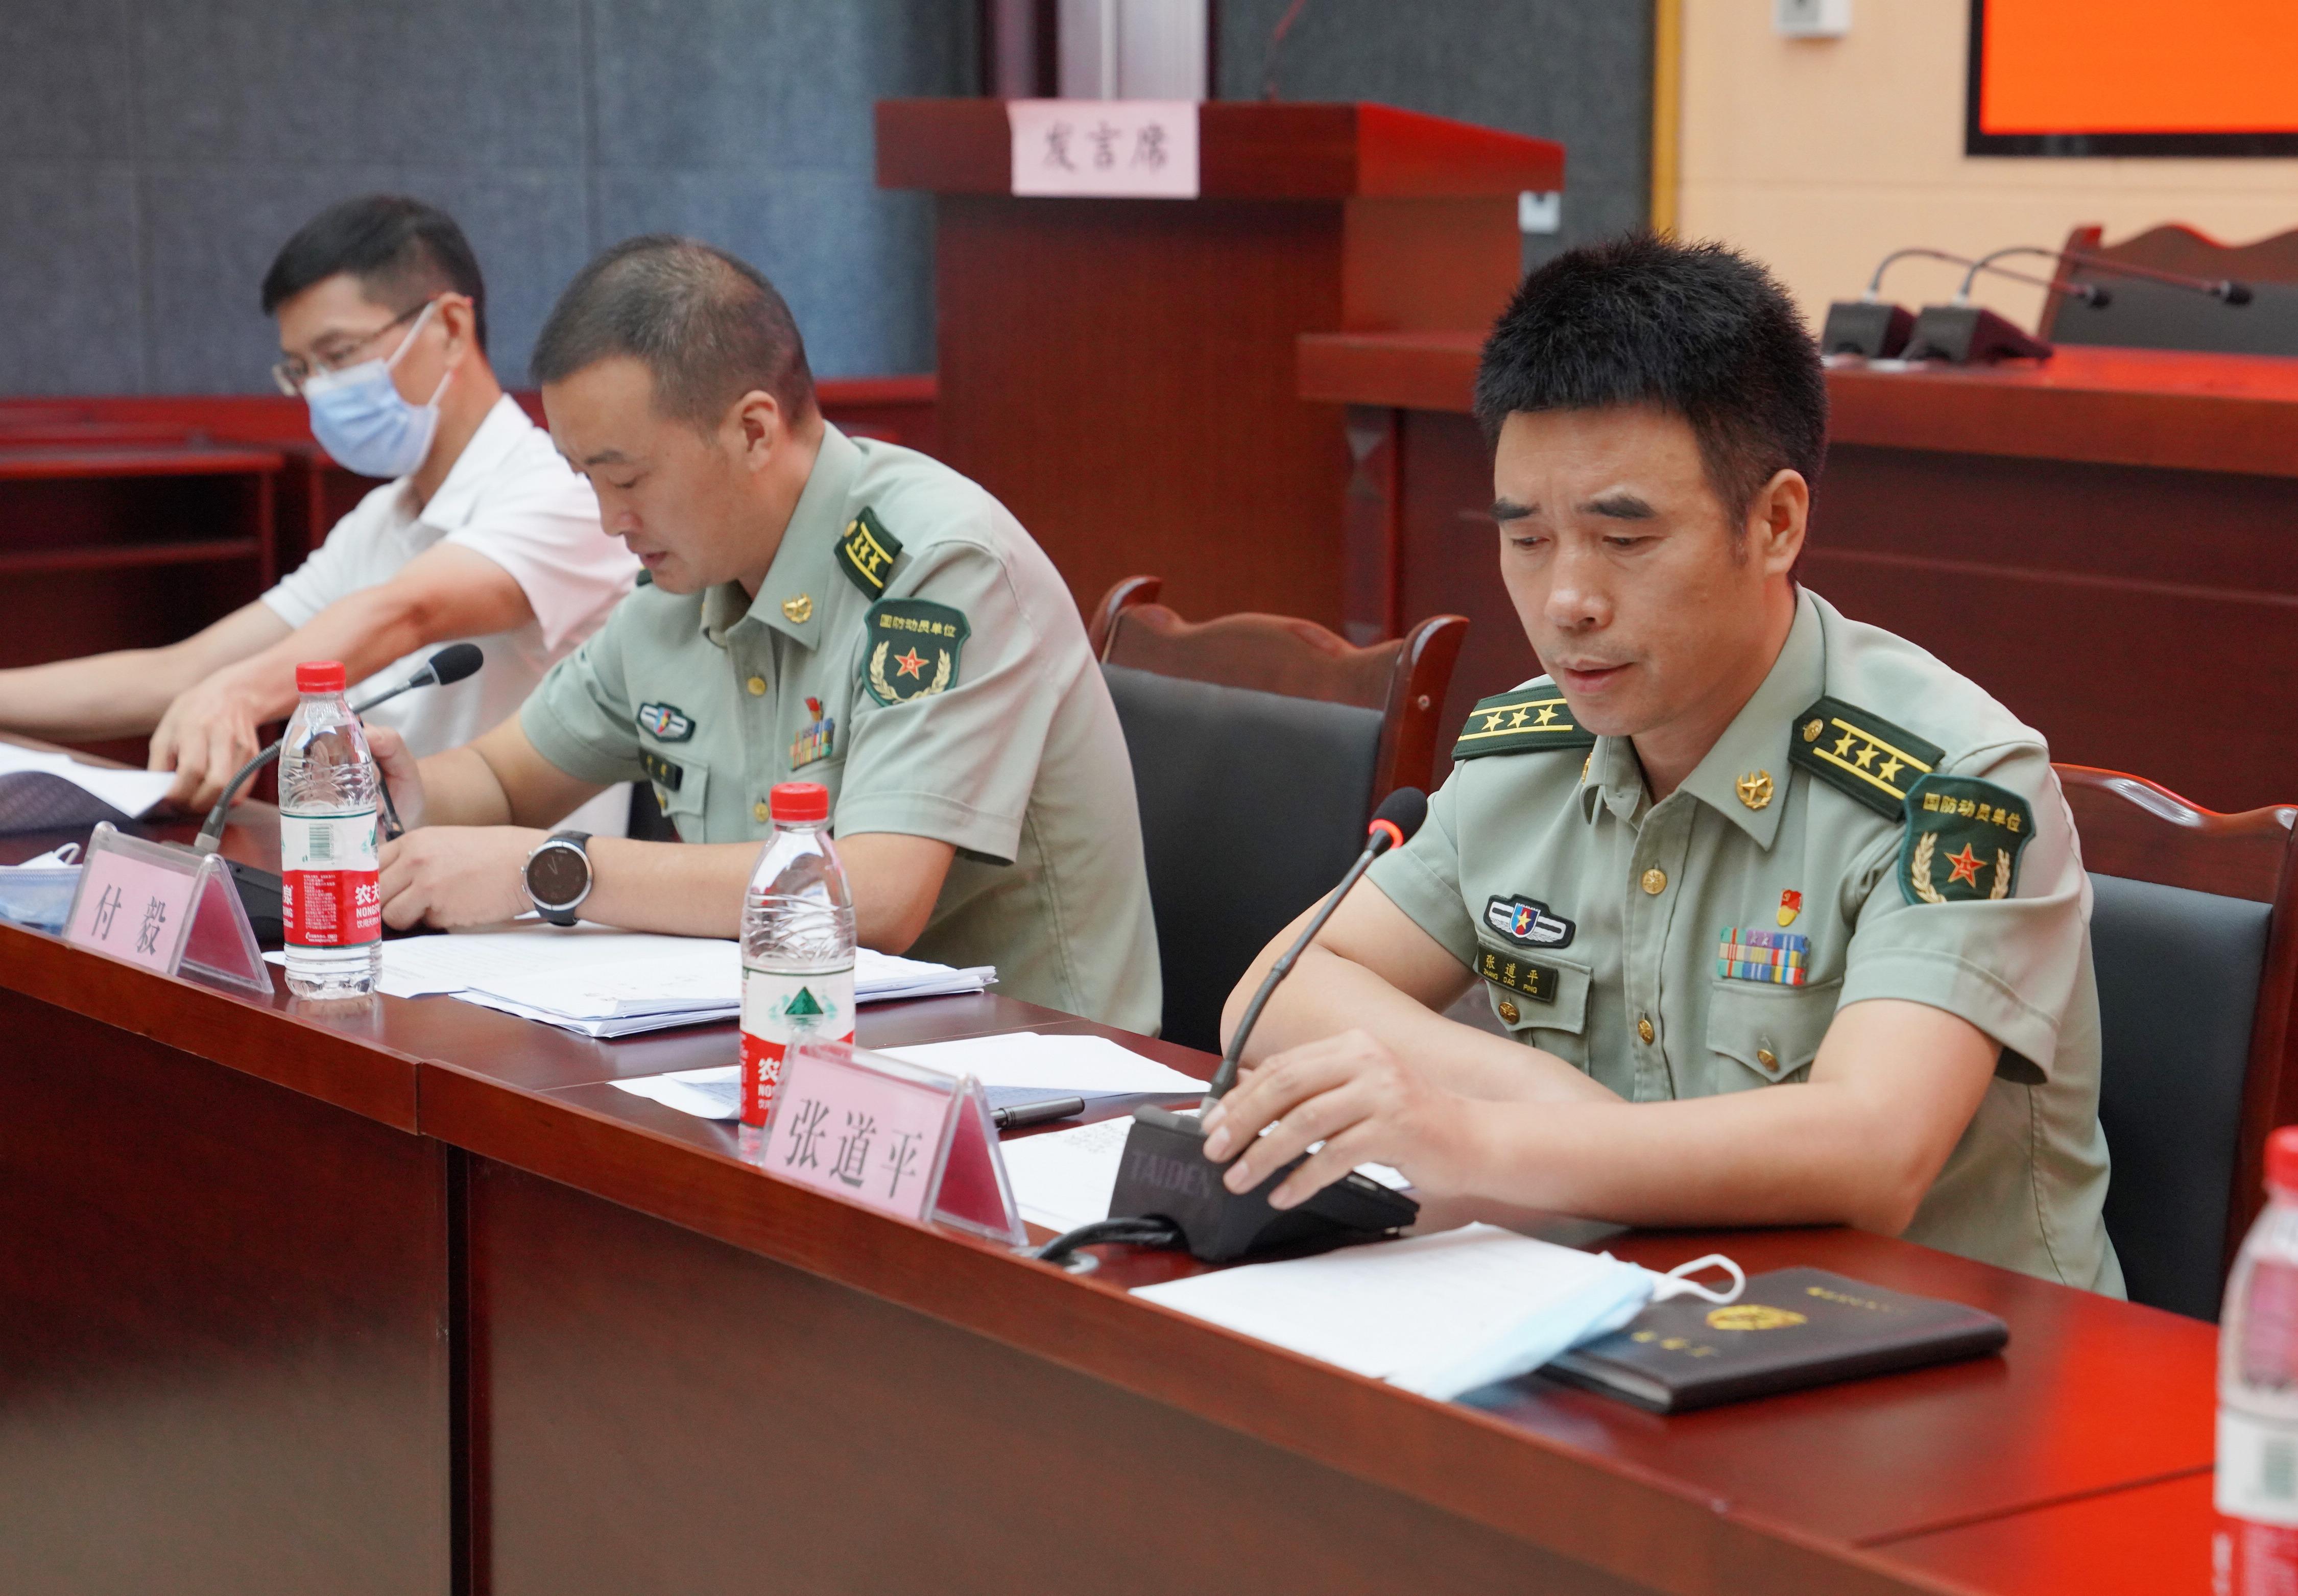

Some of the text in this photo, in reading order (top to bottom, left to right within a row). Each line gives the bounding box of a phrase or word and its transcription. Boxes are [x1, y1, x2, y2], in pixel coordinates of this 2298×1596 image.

[1042, 117, 1170, 175] 发言席
[879, 614, 956, 638] 国防动员单位
[1923, 792, 2021, 833] 国防动员单位
[91, 883, 166, 956] 付毅
[1483, 968, 1538, 994] ZHANG DAO PING
[1486, 954, 1539, 985] 张道平
[785, 1098, 922, 1199] 张道平
